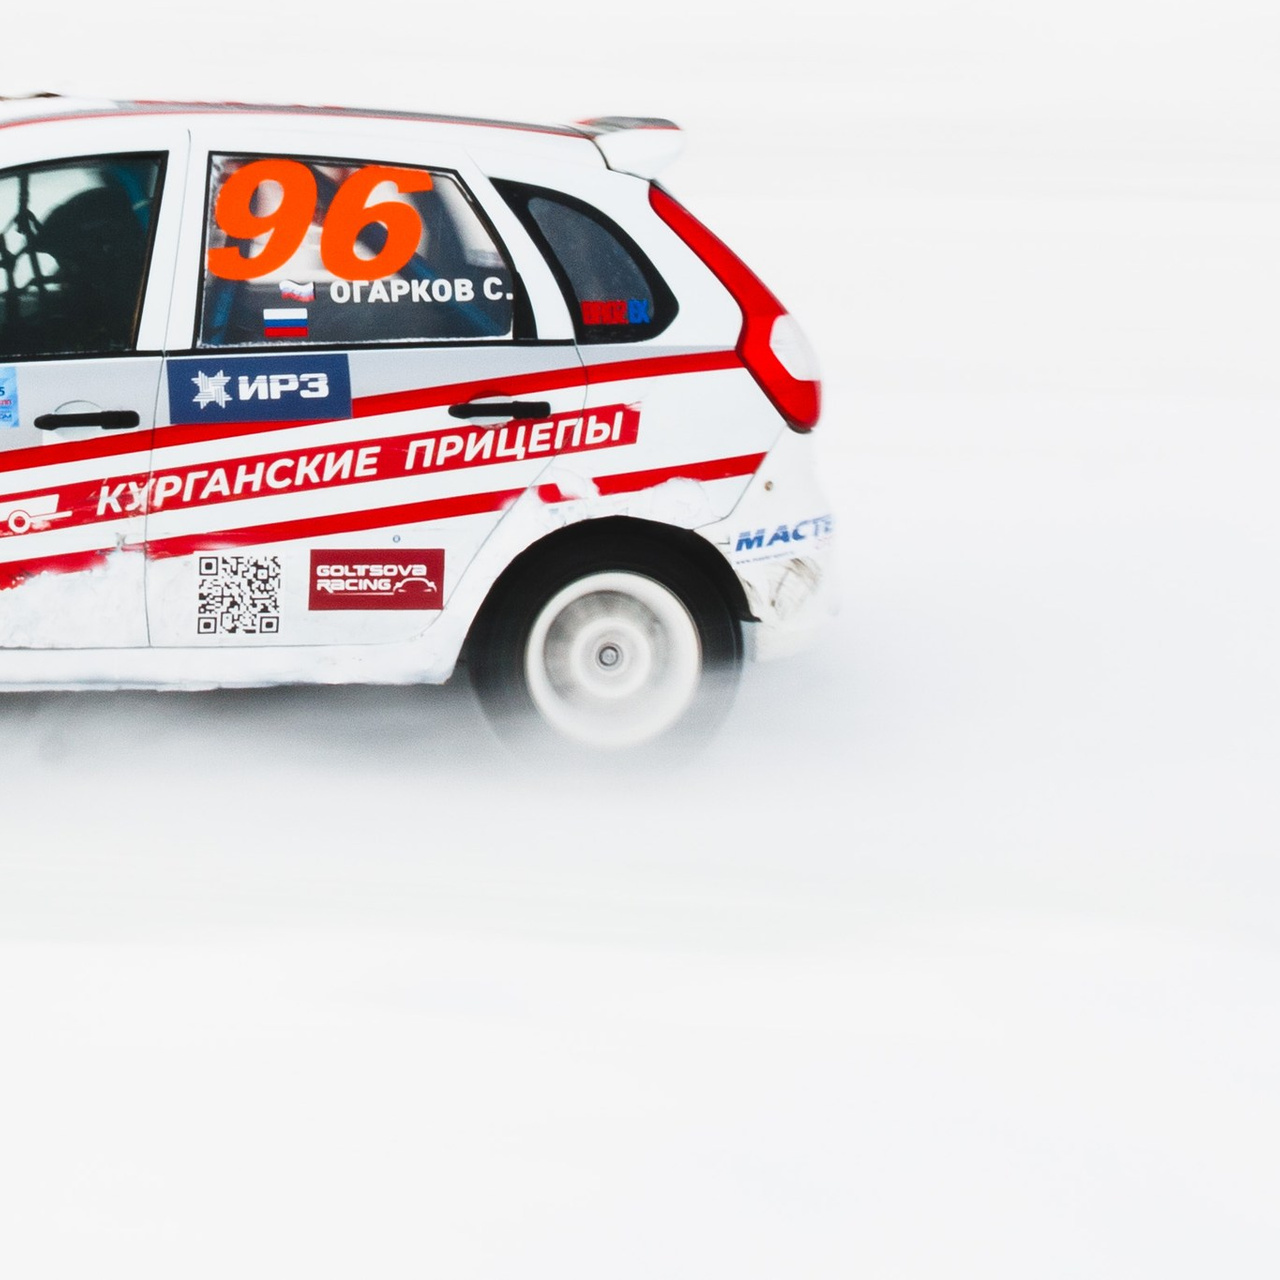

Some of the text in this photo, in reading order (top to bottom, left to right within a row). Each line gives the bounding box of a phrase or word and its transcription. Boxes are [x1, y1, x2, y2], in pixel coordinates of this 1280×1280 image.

[207, 158, 433, 281] 96
[330, 277, 514, 304] ОГАРКОВ С.
[237, 372, 330, 401] ИРЗ
[95, 411, 624, 516] КУРГАНСКИЕ ПРИЦЕПЫ
